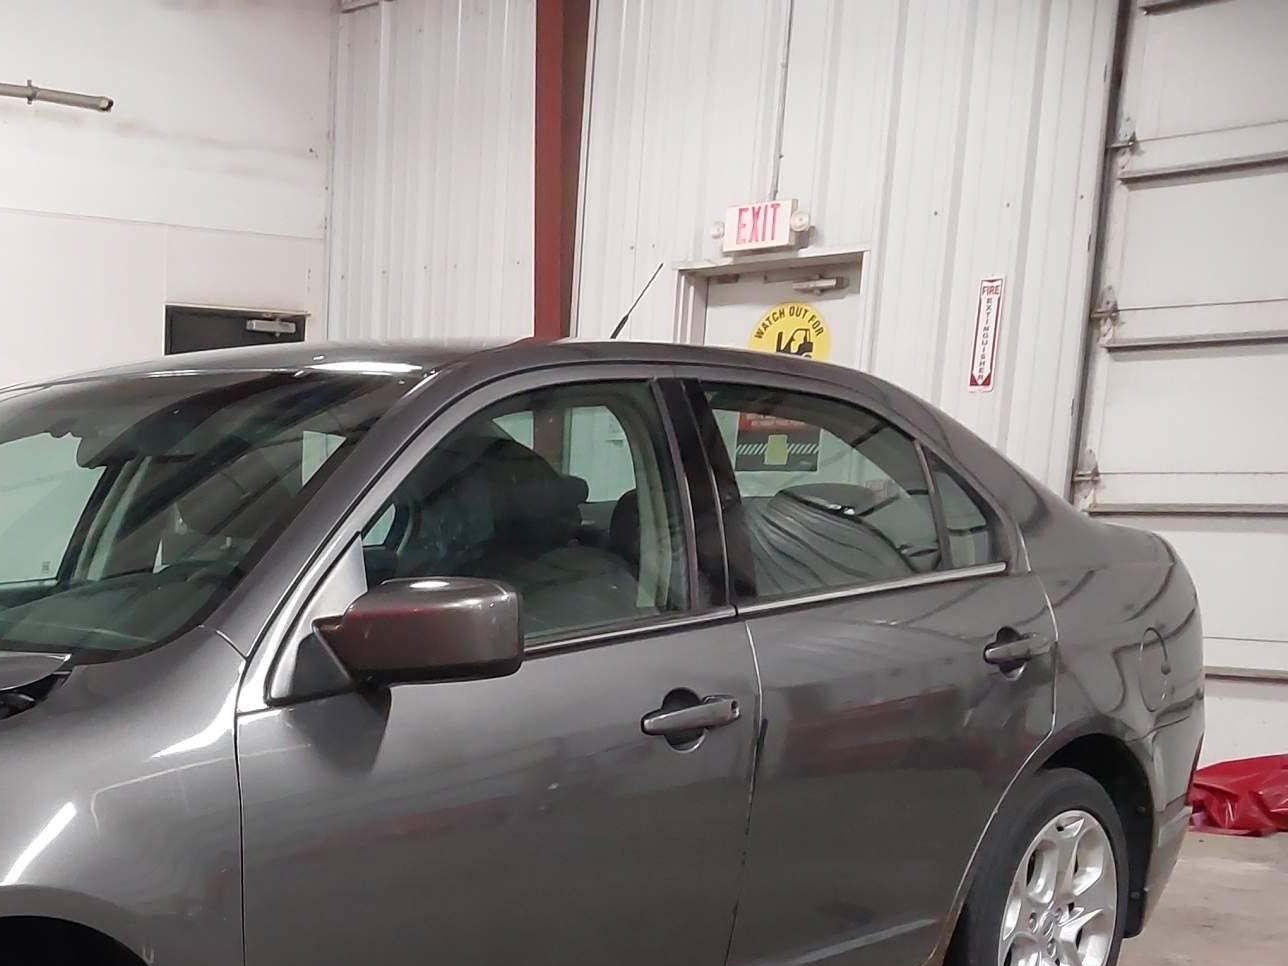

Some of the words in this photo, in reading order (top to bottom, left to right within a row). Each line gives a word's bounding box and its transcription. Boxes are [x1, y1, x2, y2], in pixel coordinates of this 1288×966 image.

[736, 203, 781, 245] EXIT
[982, 285, 1000, 295] FIRE
[754, 306, 786, 340] WATCH
[789, 305, 808, 319] OUT
[807, 314, 825, 337] FOR
[977, 298, 993, 380] EXTINGUISHER
